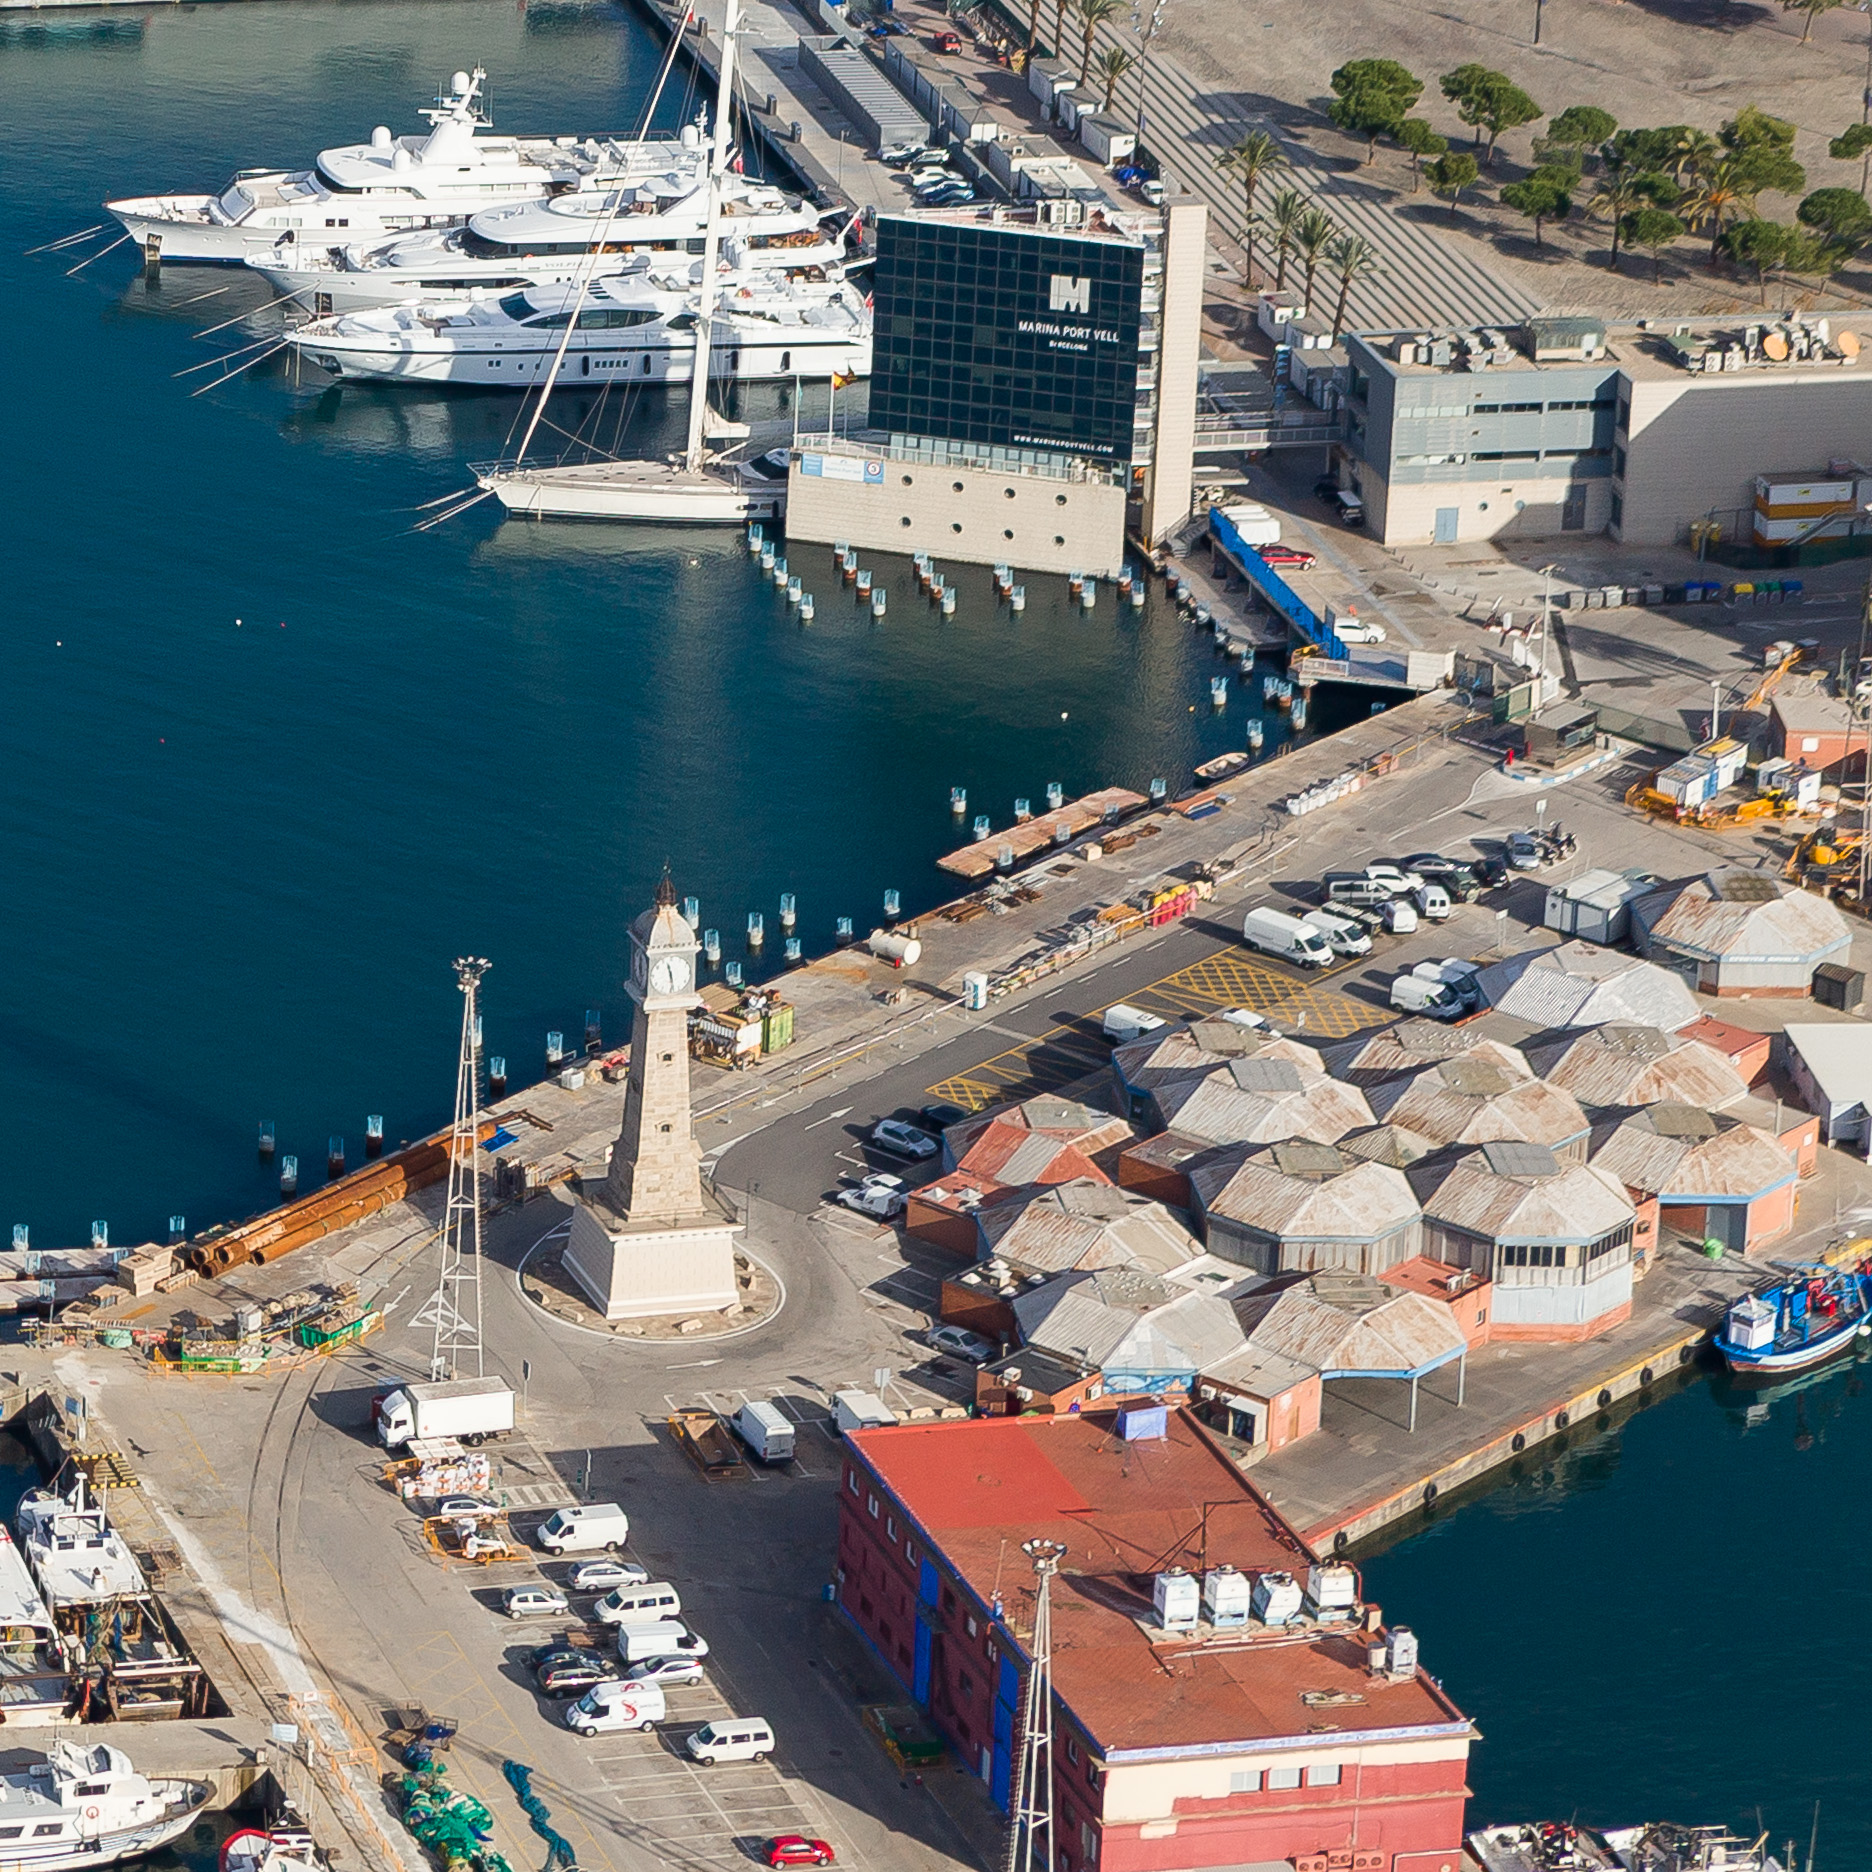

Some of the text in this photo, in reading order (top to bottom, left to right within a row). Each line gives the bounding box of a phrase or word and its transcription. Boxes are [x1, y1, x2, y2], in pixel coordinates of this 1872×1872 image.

[1018, 321, 1120, 343] MARINA PORT VELL
